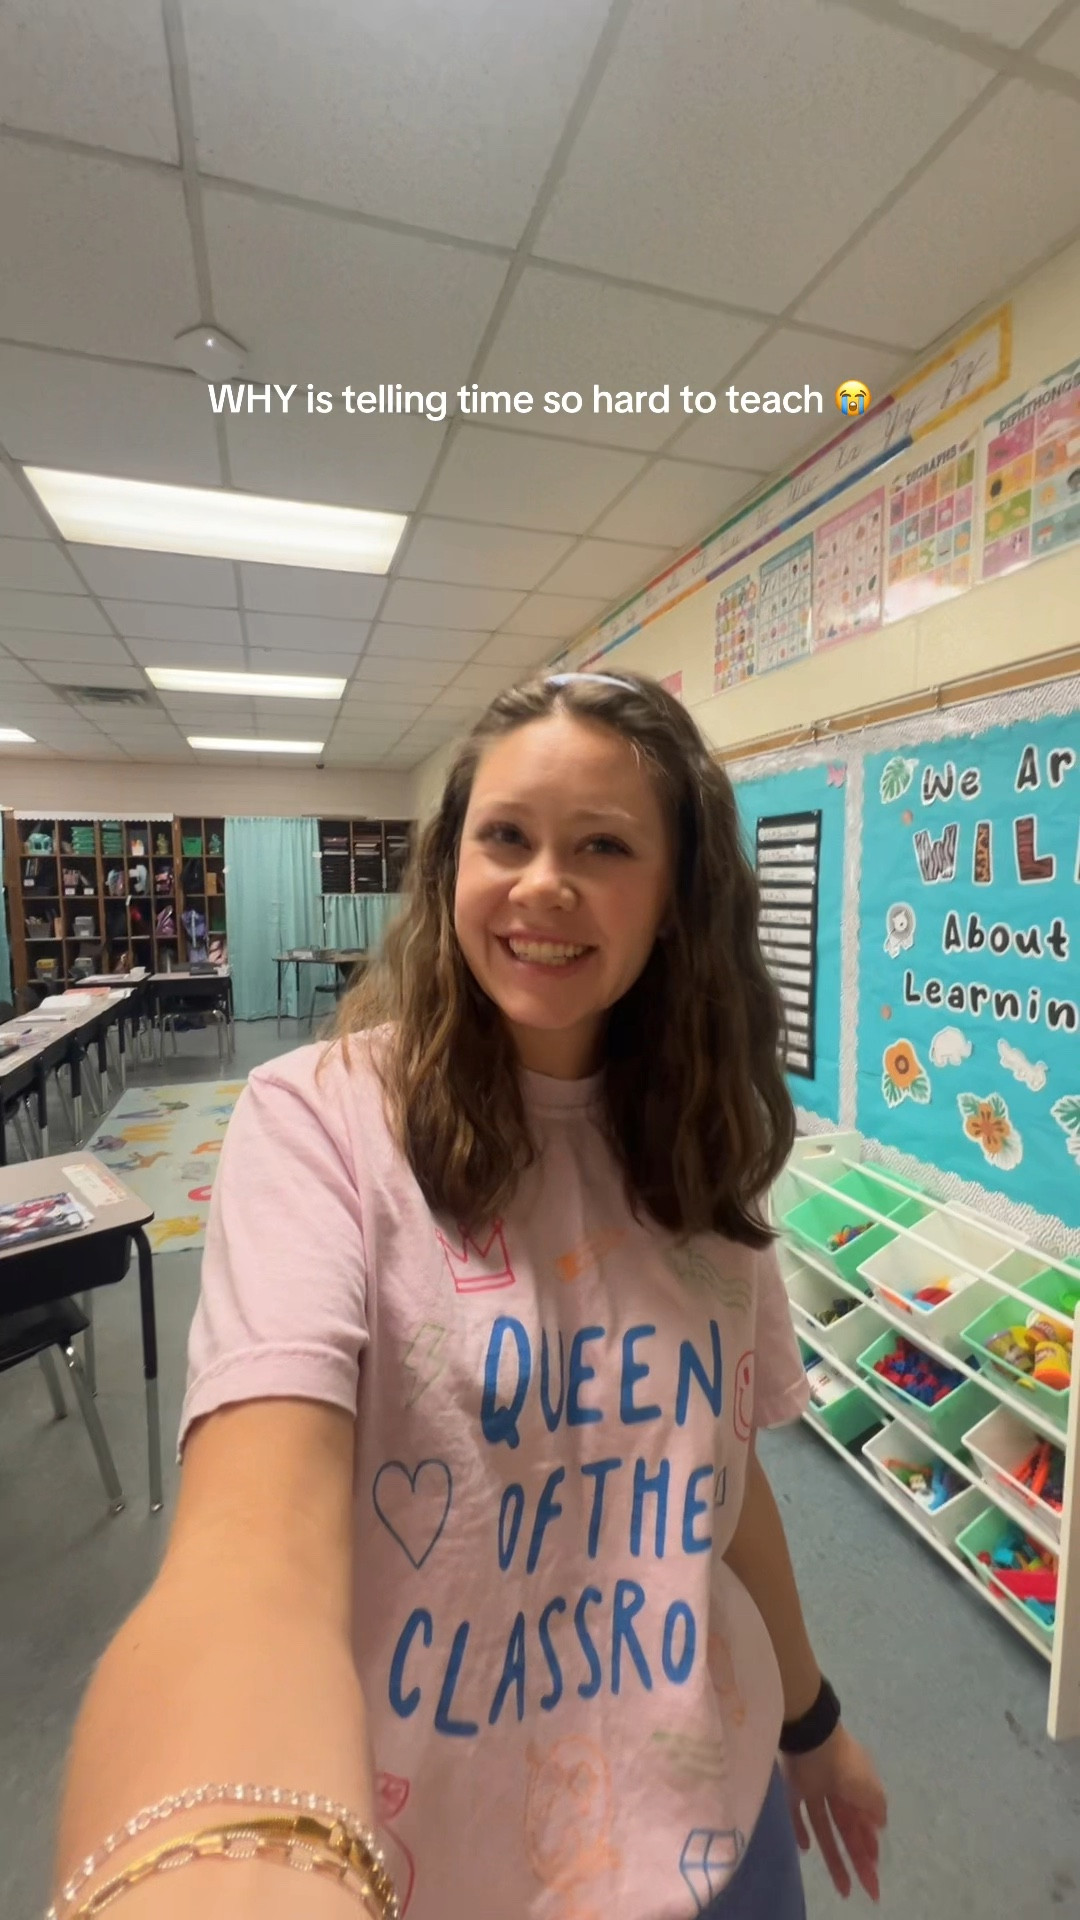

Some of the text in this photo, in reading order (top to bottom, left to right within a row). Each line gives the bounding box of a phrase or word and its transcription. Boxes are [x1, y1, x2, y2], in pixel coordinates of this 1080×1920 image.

[922, 762, 980, 804] We
[913, 814, 1080, 884] WIL
[943, 911, 1068, 960] About
[481, 1316, 723, 1447] QUEEN
[499, 1457, 713, 1575] OF THE
[388, 1579, 697, 1736] CLASSRO
